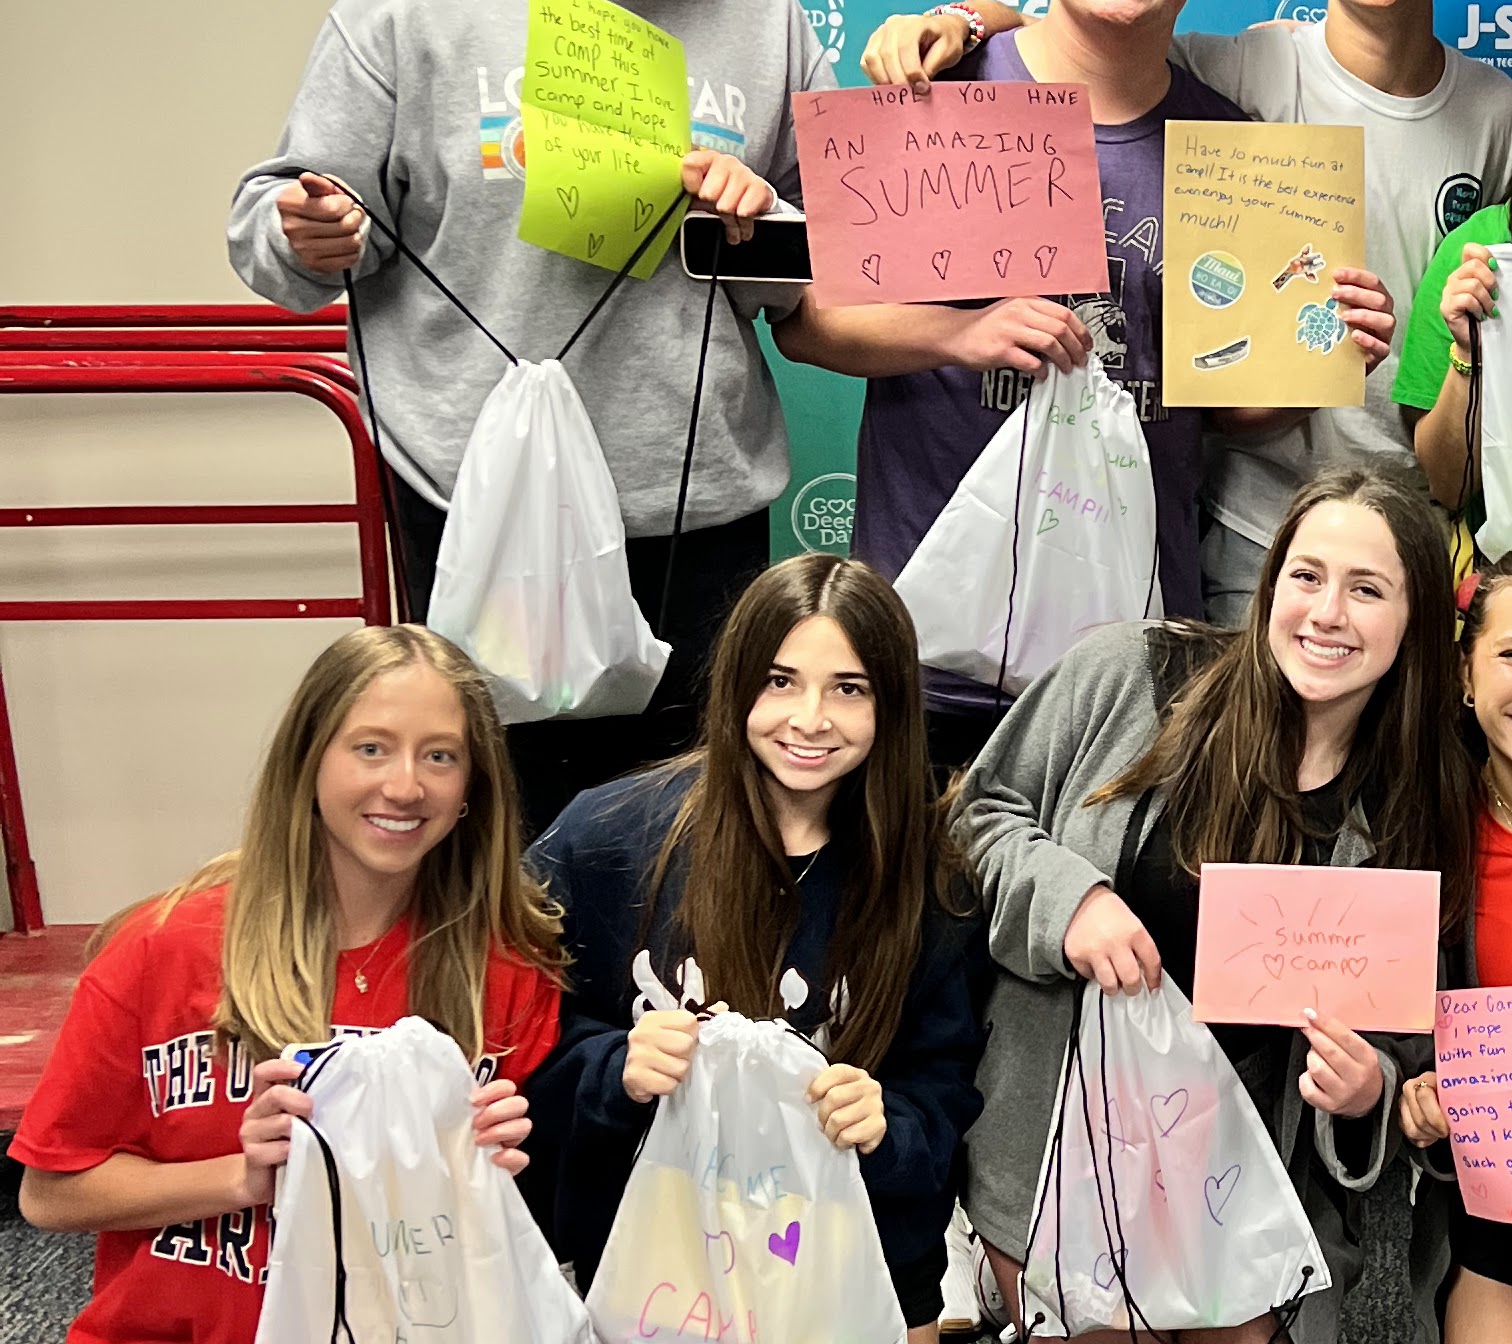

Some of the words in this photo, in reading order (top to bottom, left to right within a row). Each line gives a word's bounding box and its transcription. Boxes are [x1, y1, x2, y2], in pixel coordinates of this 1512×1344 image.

[539, 5, 564, 26] the
[569, 13, 601, 41] best
[607, 28, 635, 54] time
[641, 43, 656, 61] at
[610, 50, 641, 77] this
[810, 96, 827, 117] I
[872, 87, 924, 107] HOPE
[958, 82, 998, 103] YOU
[1027, 88, 1079, 106] HAVE
[592, 100, 624, 117] and
[630, 105, 668, 133] hope
[544, 136, 563, 153] of
[572, 146, 603, 171] your
[824, 134, 866, 160] AN
[905, 130, 1059, 156] AMAZING
[1185, 135, 1222, 158] Have
[1252, 154, 1297, 168] much
[1301, 157, 1326, 169] fun
[1331, 160, 1345, 172] at
[840, 157, 1074, 226] SUMMER
[1441, 995, 1478, 1014] Dear
[1467, 1024, 1501, 1038] hope
[1439, 1047, 1472, 1062] with
[1479, 1043, 1506, 1056] fun
[141, 1029, 217, 1118] THE
[1447, 1103, 1499, 1123] going
[1453, 1130, 1481, 1144] and
[1490, 1129, 1497, 1143] I
